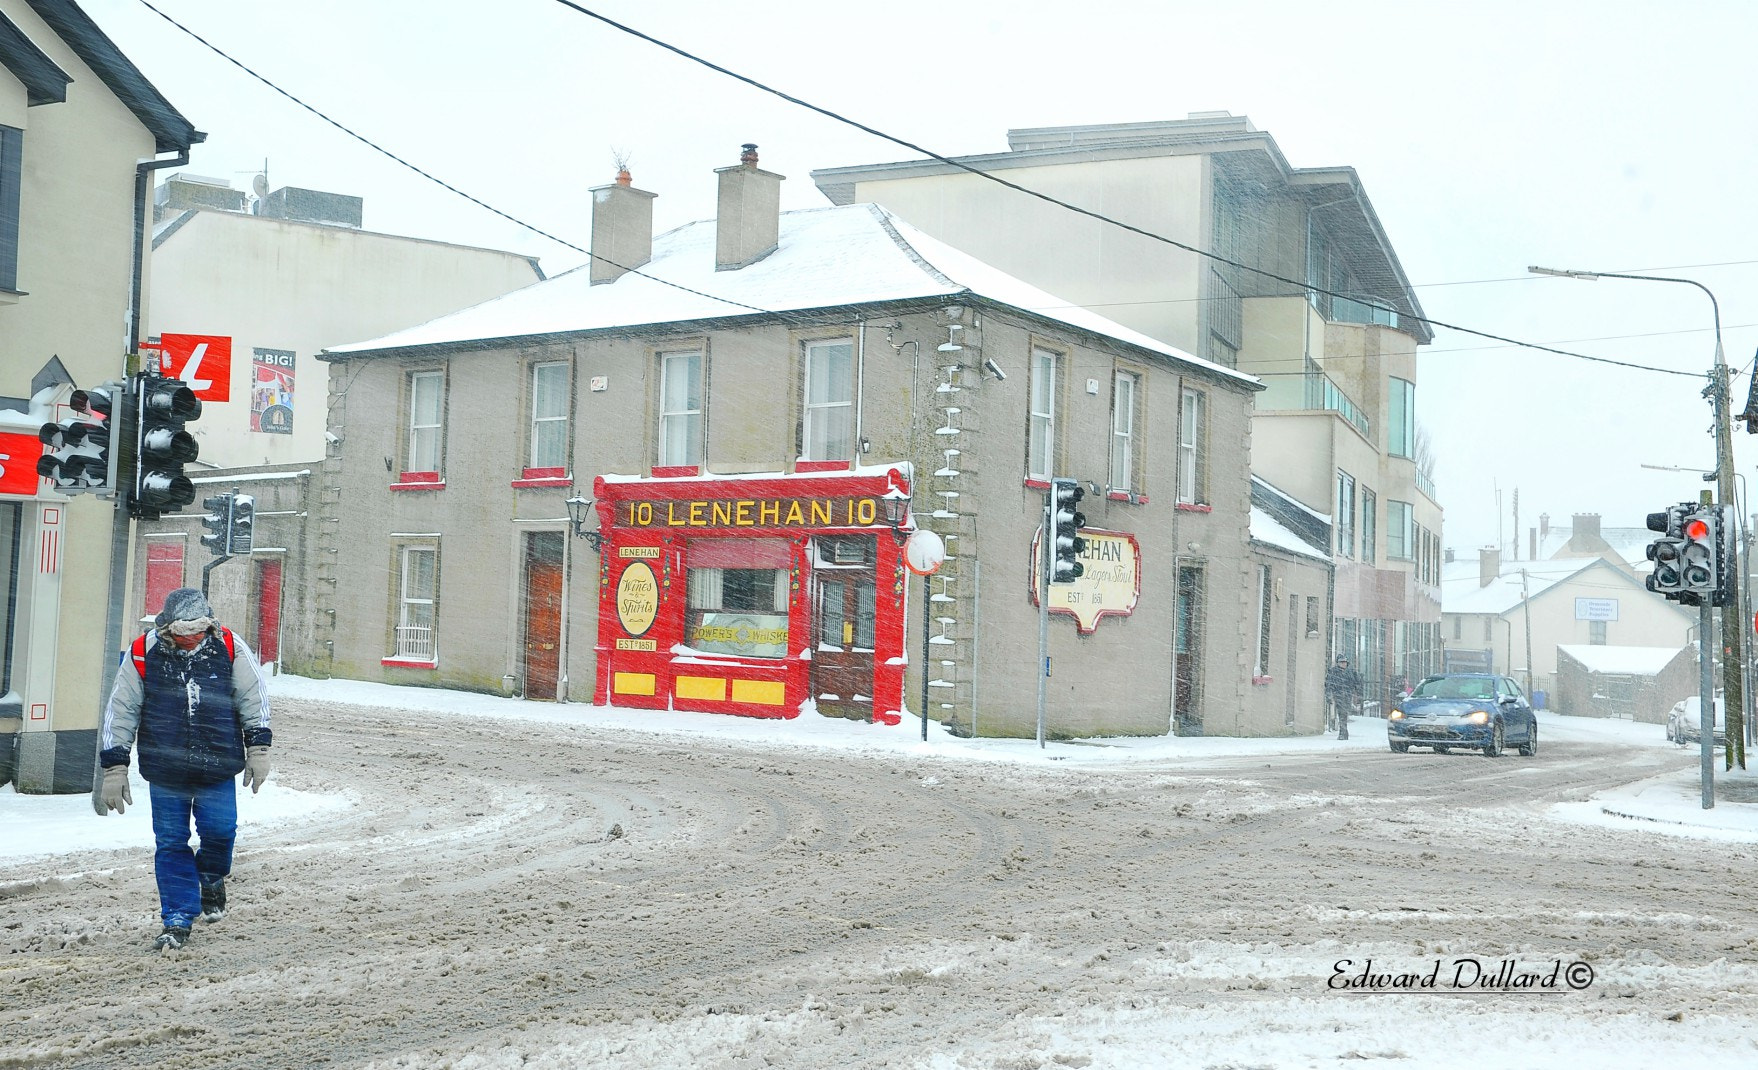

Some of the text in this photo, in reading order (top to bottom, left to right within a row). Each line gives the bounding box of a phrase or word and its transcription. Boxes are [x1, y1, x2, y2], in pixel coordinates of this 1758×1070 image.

[265, 354, 293, 367] BIG!
[630, 499, 876, 526] 10 LENEHAN 10
[620, 548, 659, 557] LENEHAN
[1076, 539, 1121, 561] EHAN
[623, 579, 652, 592] Wines
[621, 599, 653, 616] Spirits
